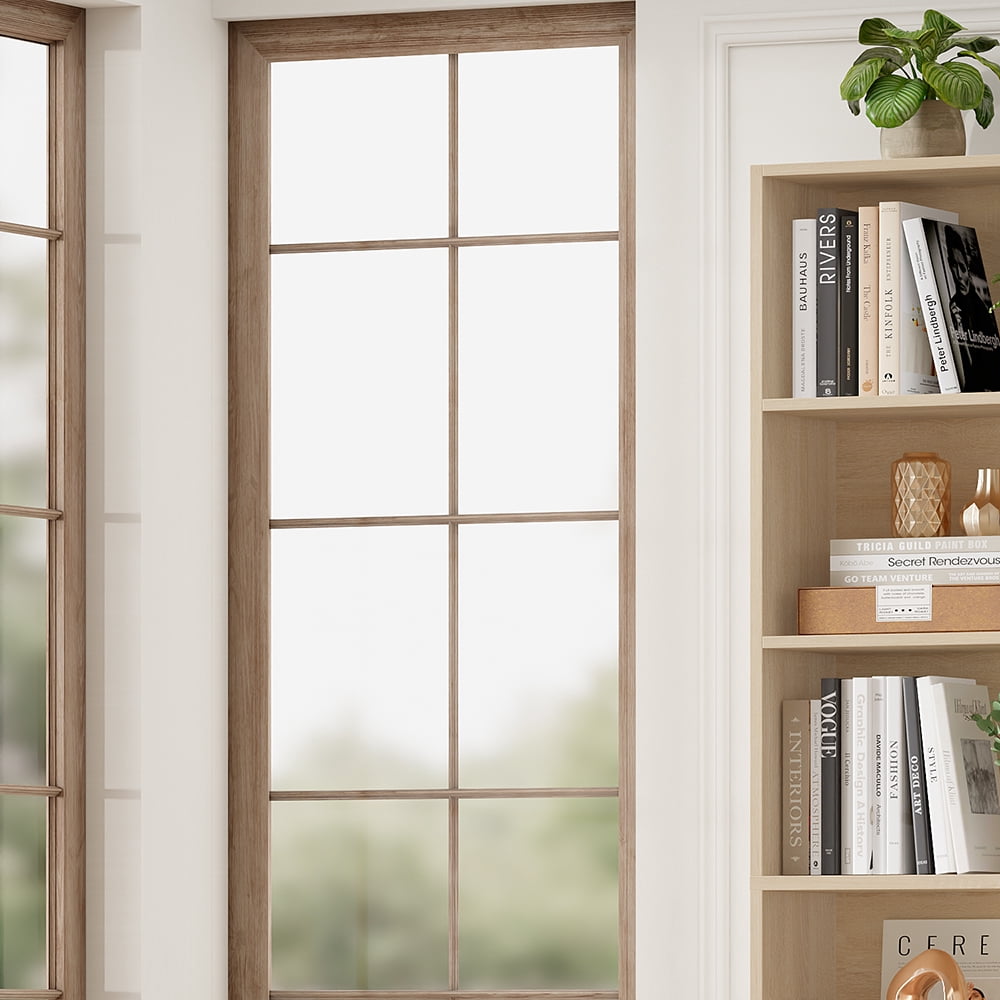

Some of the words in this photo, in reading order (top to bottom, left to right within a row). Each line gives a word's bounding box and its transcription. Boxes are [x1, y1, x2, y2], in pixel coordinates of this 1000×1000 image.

[819, 213, 837, 285] RIVERS
[799, 252, 808, 312] BAUHAUS
[884, 289, 893, 340] KINFOLK
[924, 294, 943, 346] Lindbergh
[938, 346, 949, 373] Peter
[856, 542, 894, 552] TRICIA
[899, 541, 931, 551] GUILD
[935, 540, 967, 551] PAINT
[968, 540, 988, 549] BOX
[888, 557, 926, 568] Secret
[929, 556, 1000, 568] Rendezvous
[844, 575, 860, 584] GO
[861, 574, 888, 583] TEAM
[890, 573, 933, 582] VENTURE
[821, 691, 837, 758] VOGUE
[854, 694, 865, 746] Graphic
[789, 730, 802, 847] INTERIORS
[854, 752, 865, 797] Design
[889, 740, 898, 799] FASHION
[910, 755, 922, 788] DECO
[928, 746, 938, 783] STYLE
[812, 771, 820, 857] ATMOSPHERE
[912, 791, 923, 815] ART
